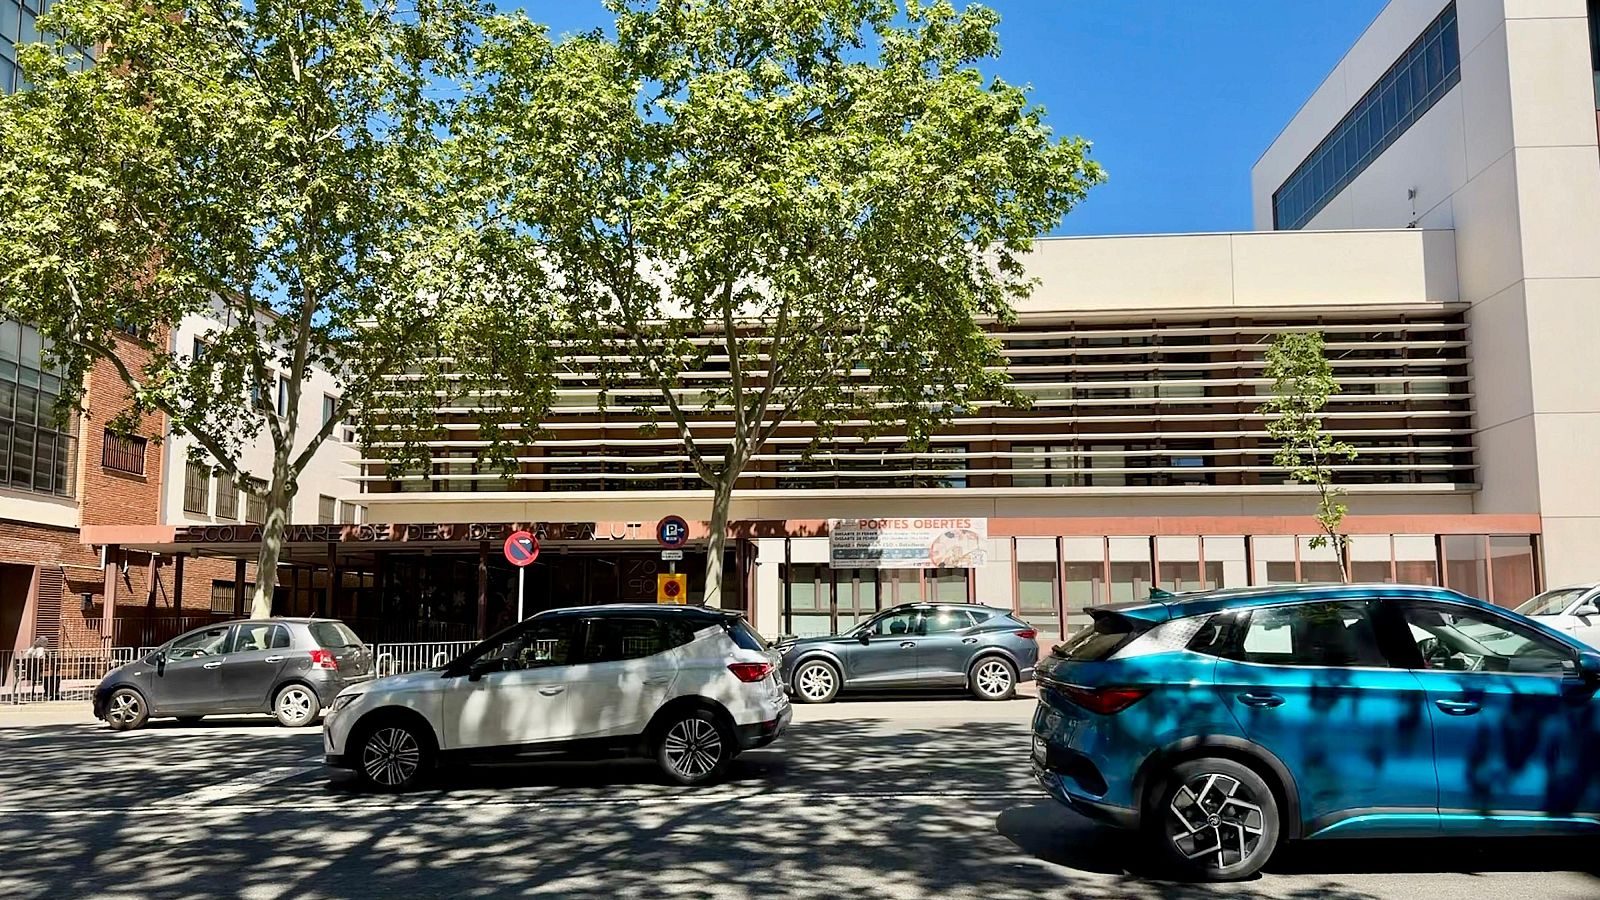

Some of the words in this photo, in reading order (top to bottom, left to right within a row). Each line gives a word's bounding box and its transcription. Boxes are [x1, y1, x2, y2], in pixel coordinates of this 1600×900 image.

[859, 519, 908, 530] PORTES
[914, 519, 971, 529] OBERTES
[174, 525, 264, 542] ESCOLA
[281, 525, 343, 541] MARE
[359, 523, 390, 541] DE
[469, 523, 500, 540] DE
[564, 523, 642, 541] SALUT
